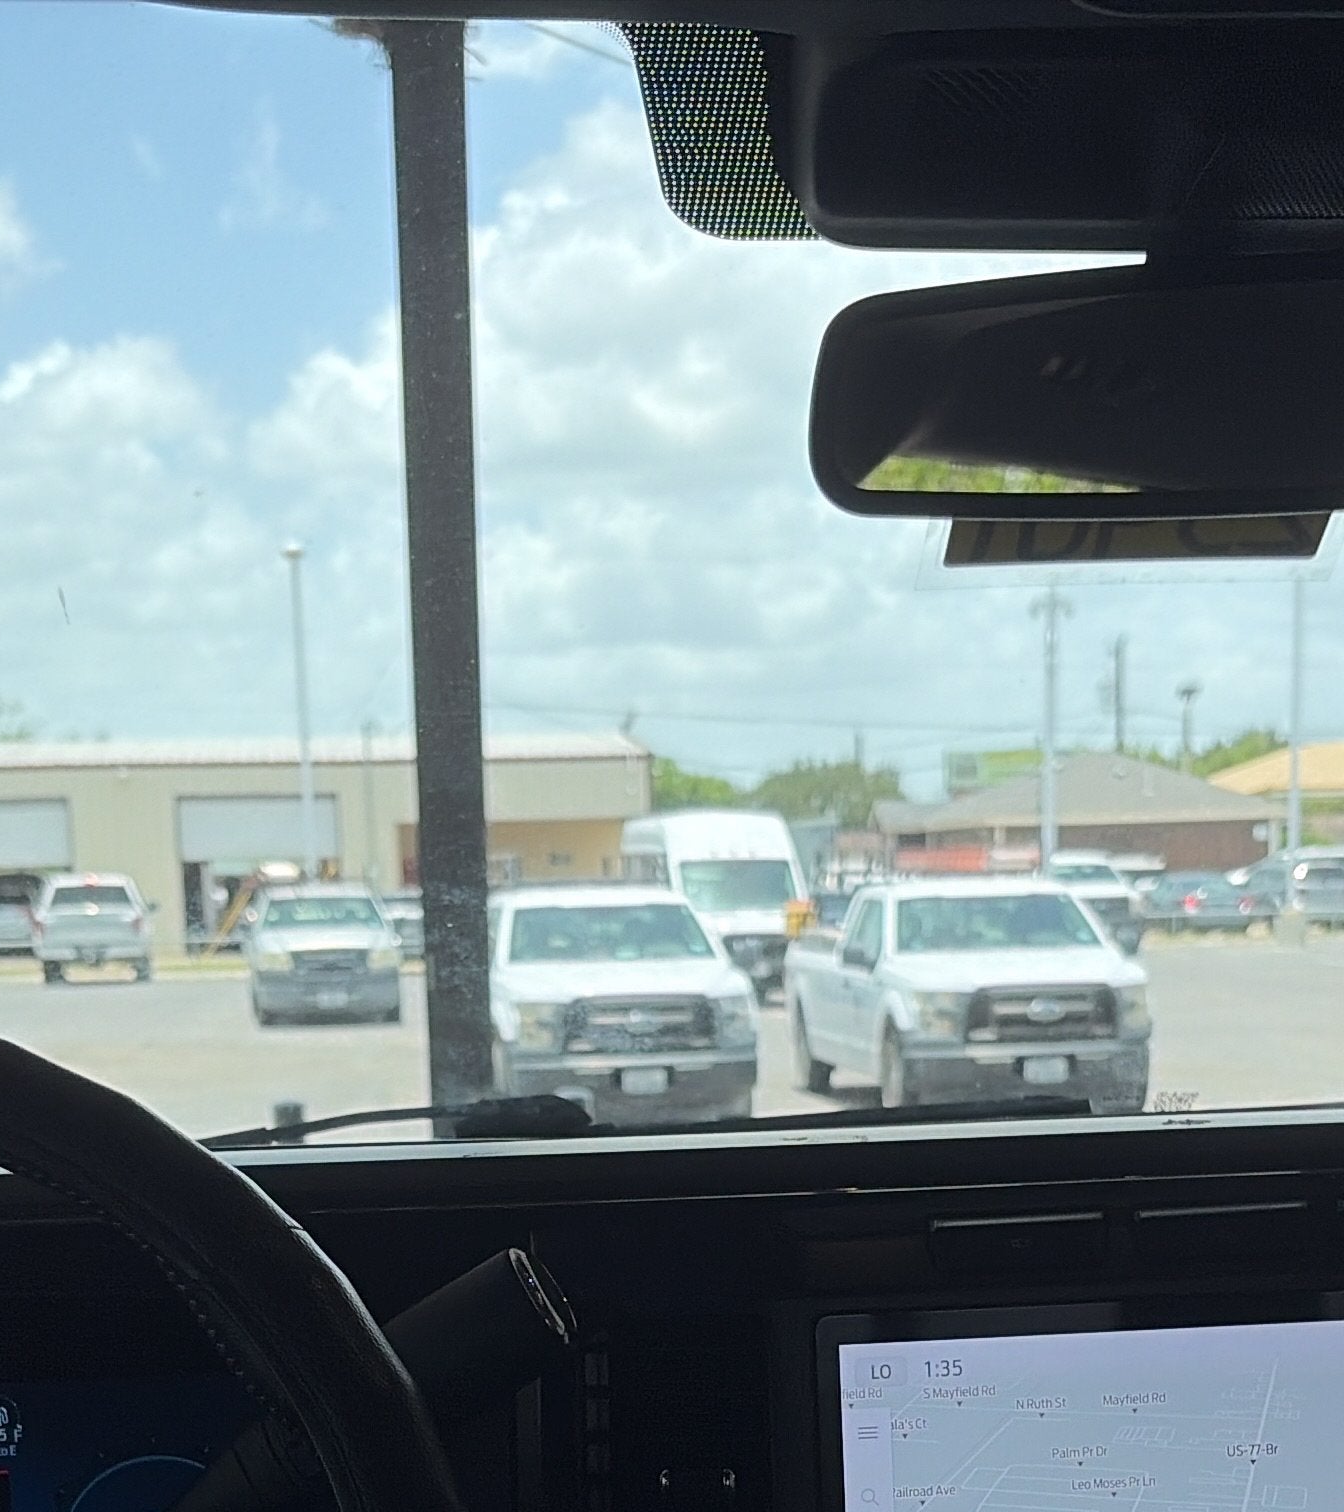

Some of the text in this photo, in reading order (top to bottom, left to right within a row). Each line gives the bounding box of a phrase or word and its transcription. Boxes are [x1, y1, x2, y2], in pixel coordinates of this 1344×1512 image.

[871, 1364, 892, 1380] LO
[924, 1359, 963, 1378] 1:35
[868, 1387, 883, 1399] Rd
[923, 1384, 997, 1401] S Mayfield Rd
[1102, 1391, 1167, 1408] Mayfield Rd
[1016, 1397, 1067, 1410] N Ruth St
[915, 1417, 928, 1430] Ct
[1052, 1445, 1107, 1459] Palm Pr Dr
[1226, 1444, 1279, 1458] US-77-Br
[935, 1484, 956, 1496] Ave
[1072, 1476, 1156, 1491] Leo Moses Pr Ln
